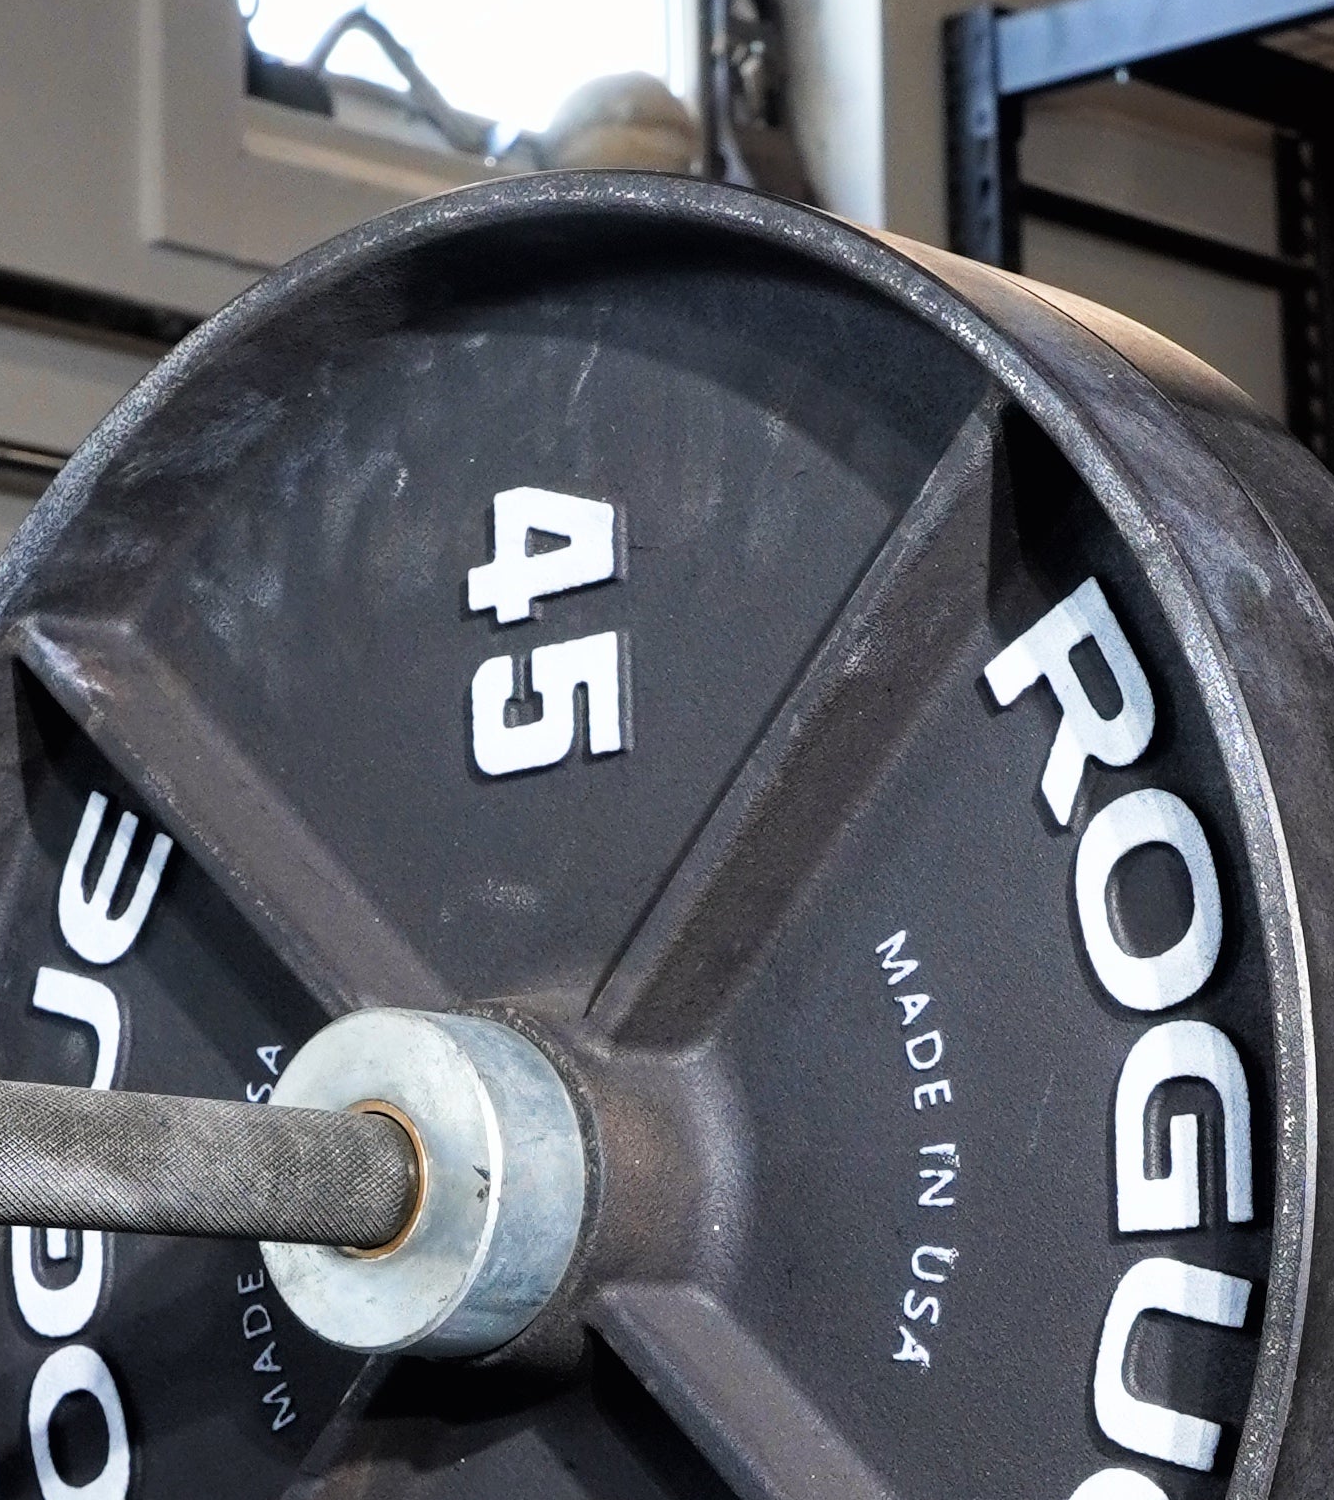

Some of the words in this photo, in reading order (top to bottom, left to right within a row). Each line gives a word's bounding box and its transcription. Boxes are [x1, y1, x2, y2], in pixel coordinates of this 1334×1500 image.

[468, 486, 621, 775] 45
[246, 1045, 284, 1103] SA
[875, 930, 953, 1110] MADE
[918, 1143, 958, 1207] IN
[237, 1269, 296, 1431] MADE
[892, 1245, 959, 1368] USA
